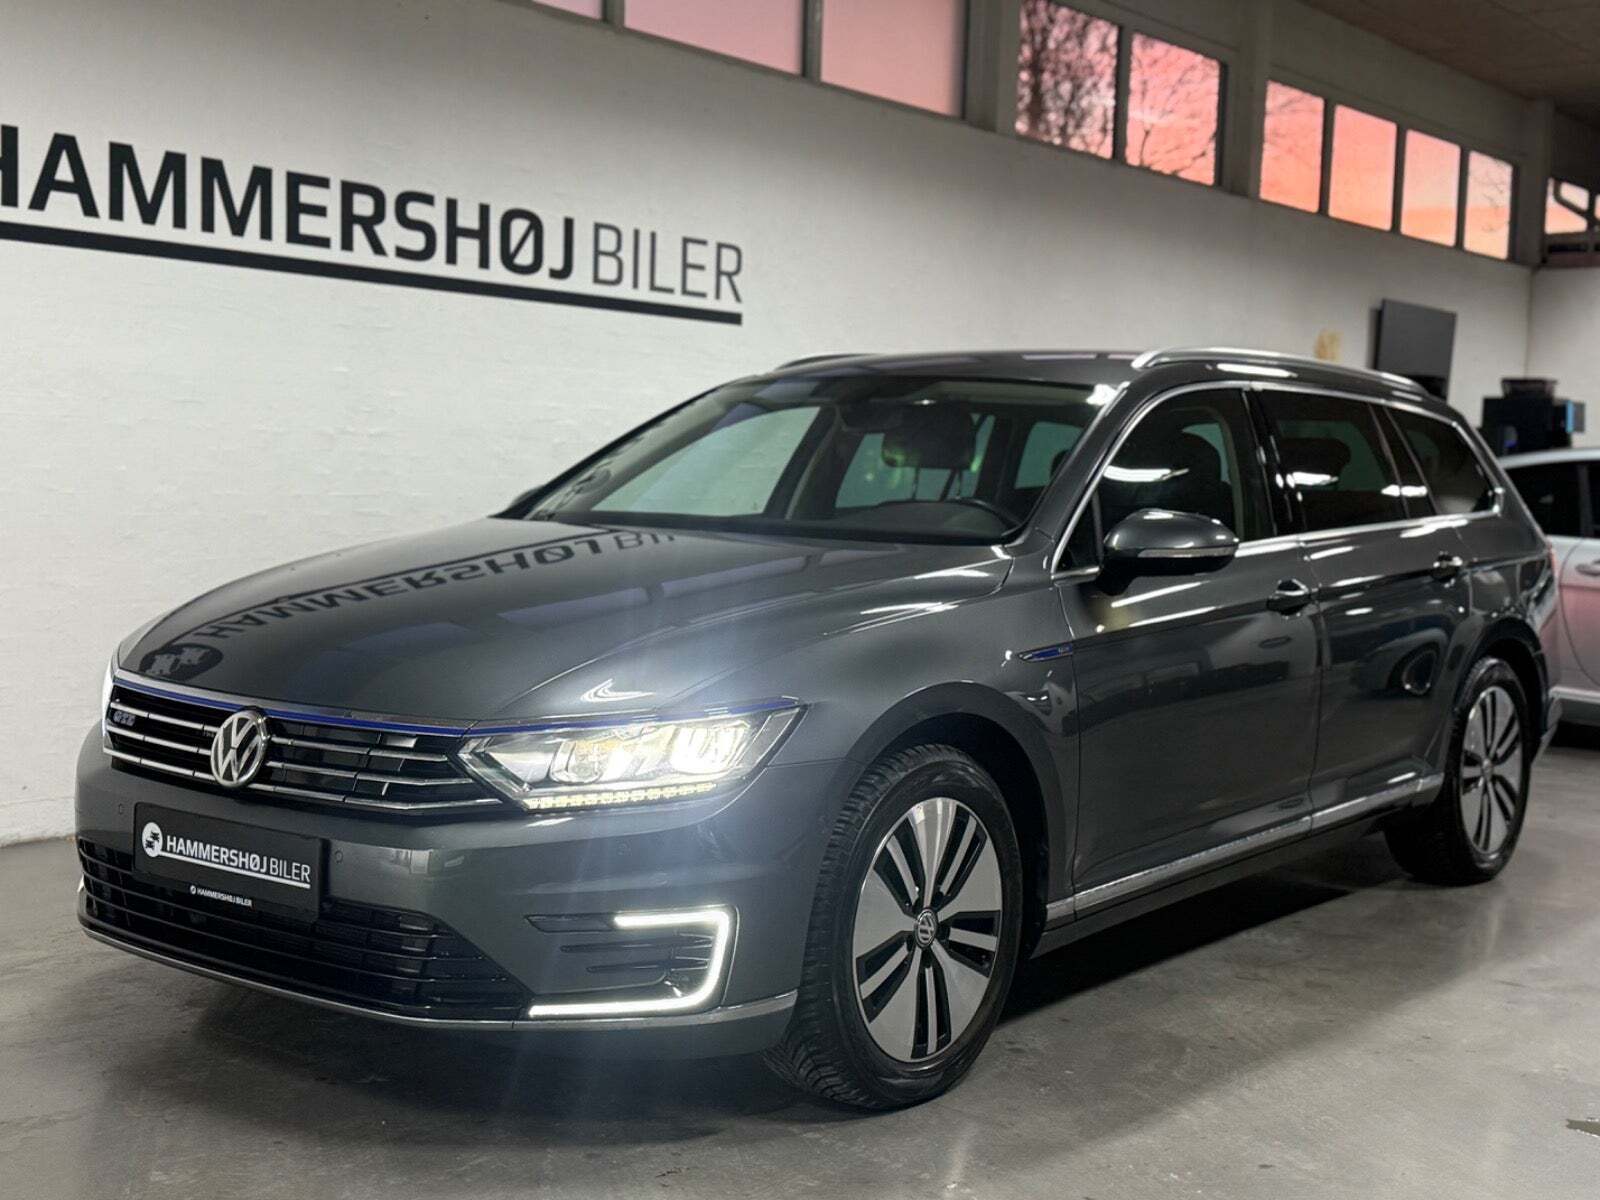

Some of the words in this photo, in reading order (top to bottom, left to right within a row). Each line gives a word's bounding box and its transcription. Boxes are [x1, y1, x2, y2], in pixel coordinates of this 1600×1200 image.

[592, 222, 744, 303] BILER
[166, 835, 268, 873] HAMMERSHØJ
[269, 857, 311, 883] BILER
